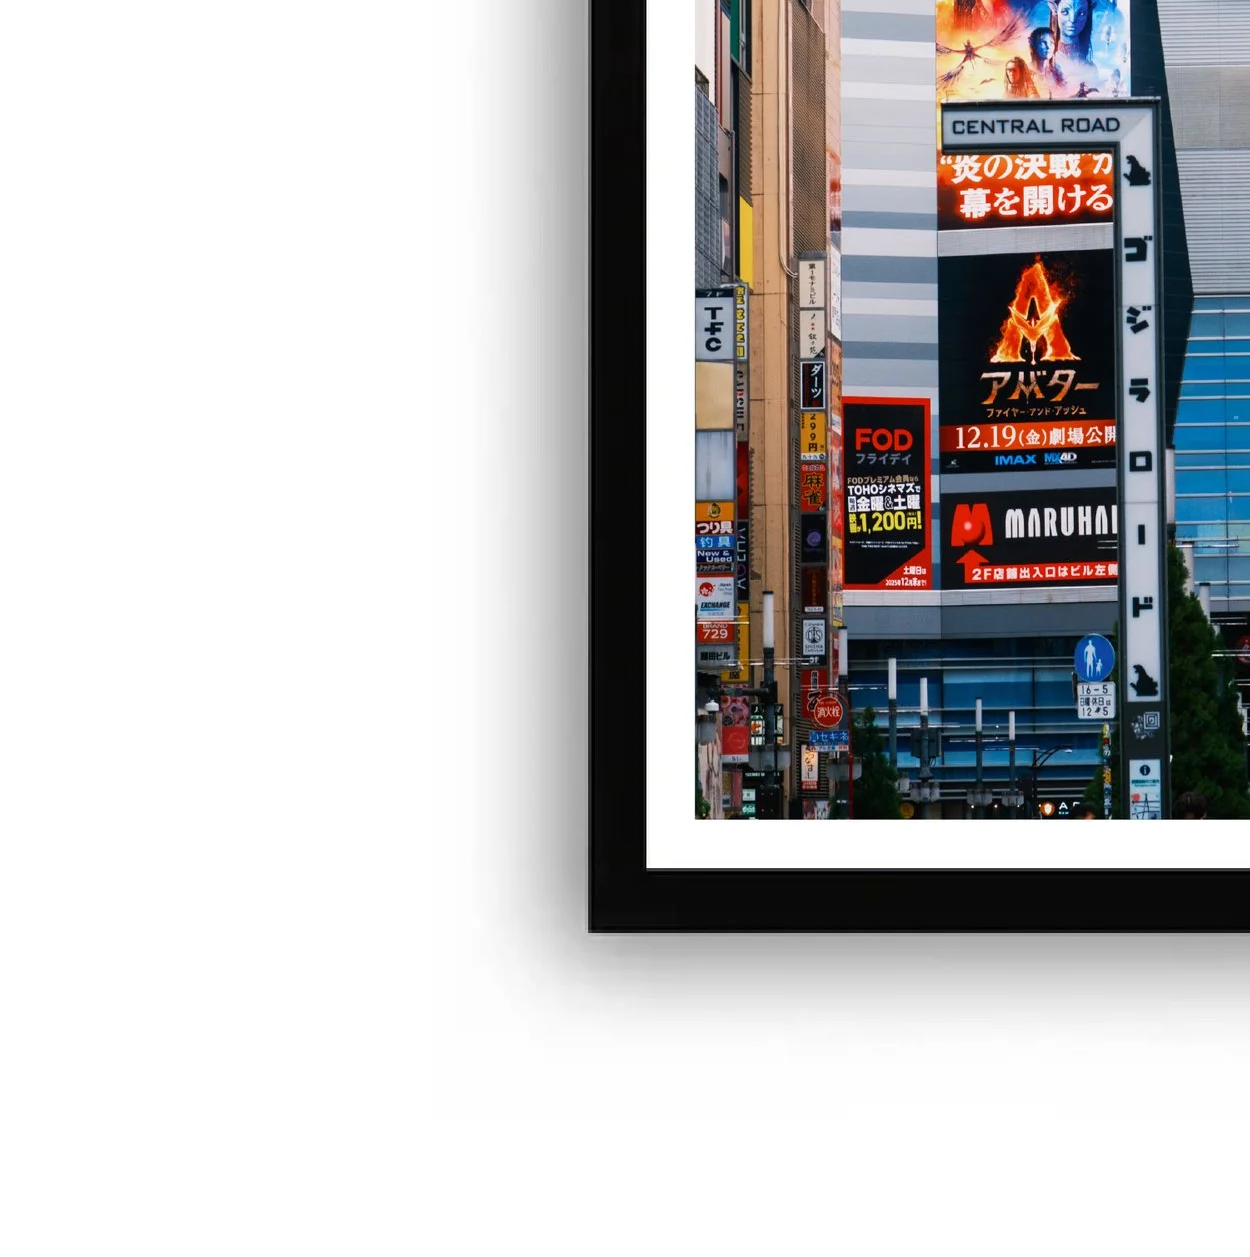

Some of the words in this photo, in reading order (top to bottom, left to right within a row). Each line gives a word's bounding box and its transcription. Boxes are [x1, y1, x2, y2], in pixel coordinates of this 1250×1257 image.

[952, 119, 1054, 135] CENTRAL
[1061, 117, 1120, 133] ROAD
[959, 184, 1114, 219] 幕を開ける
[810, 363, 823, 399] ダーツ
[980, 368, 1100, 405] アバター
[856, 428, 913, 451] FOD
[995, 454, 1037, 466] IMAX
[848, 482, 921, 496] TOHOシネマズで
[697, 521, 733, 534] つり具
[700, 601, 731, 609] EXCHANGE
[703, 629, 728, 639] 729
[816, 706, 840, 719] 消火栓
